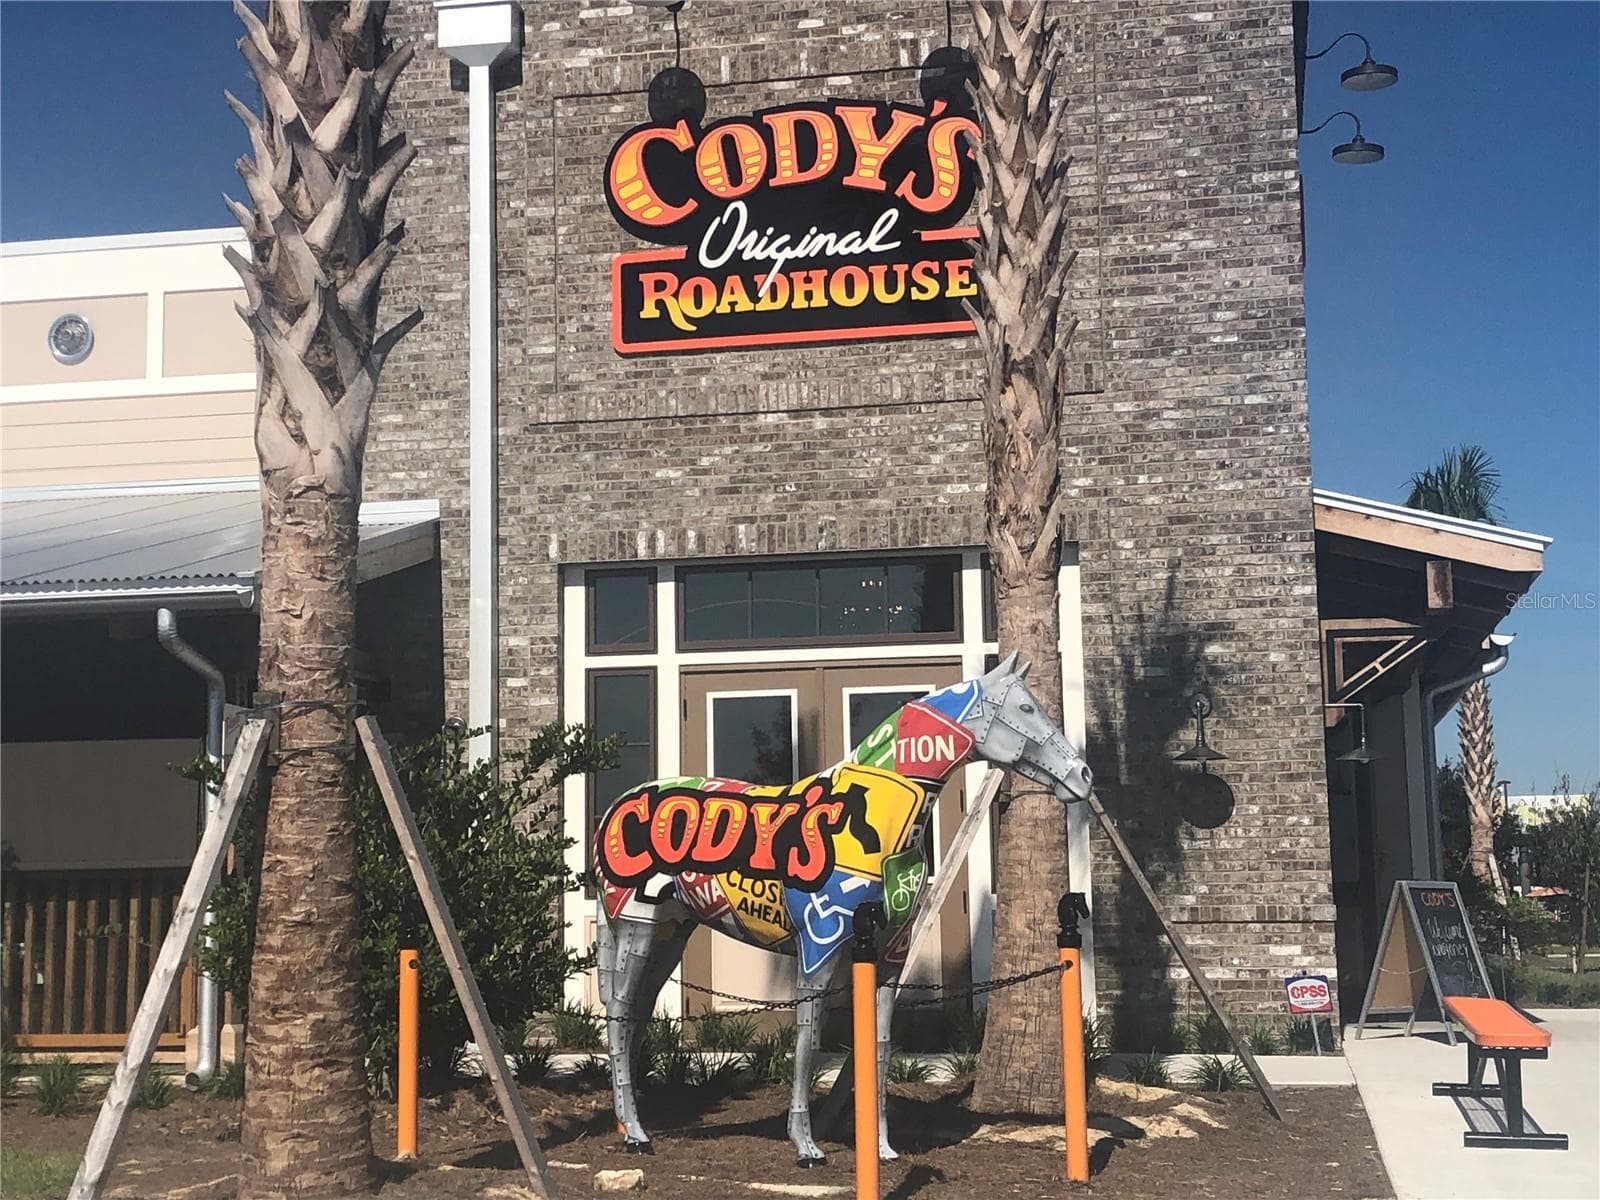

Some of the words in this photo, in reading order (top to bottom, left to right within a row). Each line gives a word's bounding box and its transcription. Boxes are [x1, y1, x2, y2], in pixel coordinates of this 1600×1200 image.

[609, 100, 982, 226] CODY'S
[699, 199, 902, 298] Original
[638, 258, 978, 332] ROADHOUSE
[897, 734, 956, 764] TION
[603, 784, 843, 880] CODY'S
[726, 870, 784, 906] CLOS
[1290, 984, 1328, 999] CPSS
